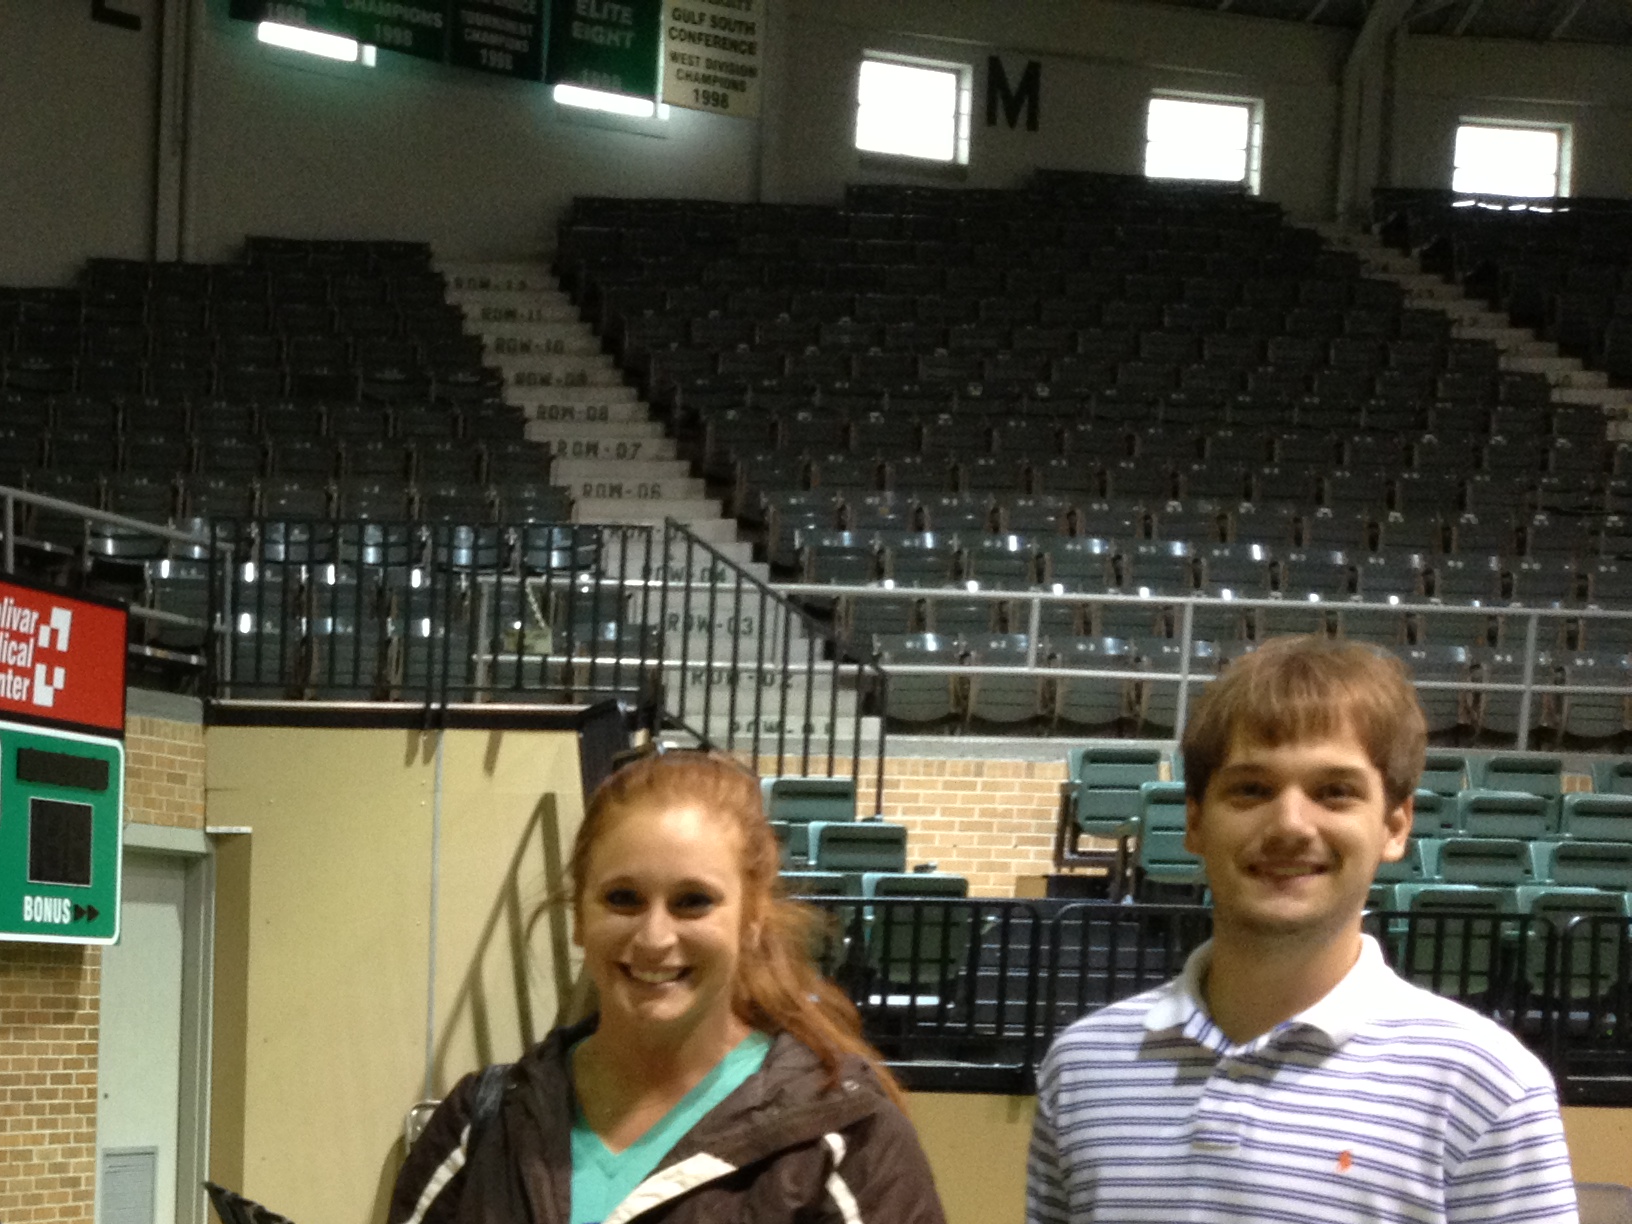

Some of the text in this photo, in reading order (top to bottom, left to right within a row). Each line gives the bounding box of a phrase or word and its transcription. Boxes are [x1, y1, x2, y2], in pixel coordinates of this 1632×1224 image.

[571, 21, 635, 48] EIGHT
[671, 7, 756, 35] GULF SOUTH
[668, 26, 758, 55] CONFERENCE
[668, 51, 758, 78] WEST DIVISION
[676, 68, 747, 93] CHAMPIONS
[986, 55, 1041, 132] M
[693, 88, 729, 109] 1998
[22, 895, 72, 925] BONUS
